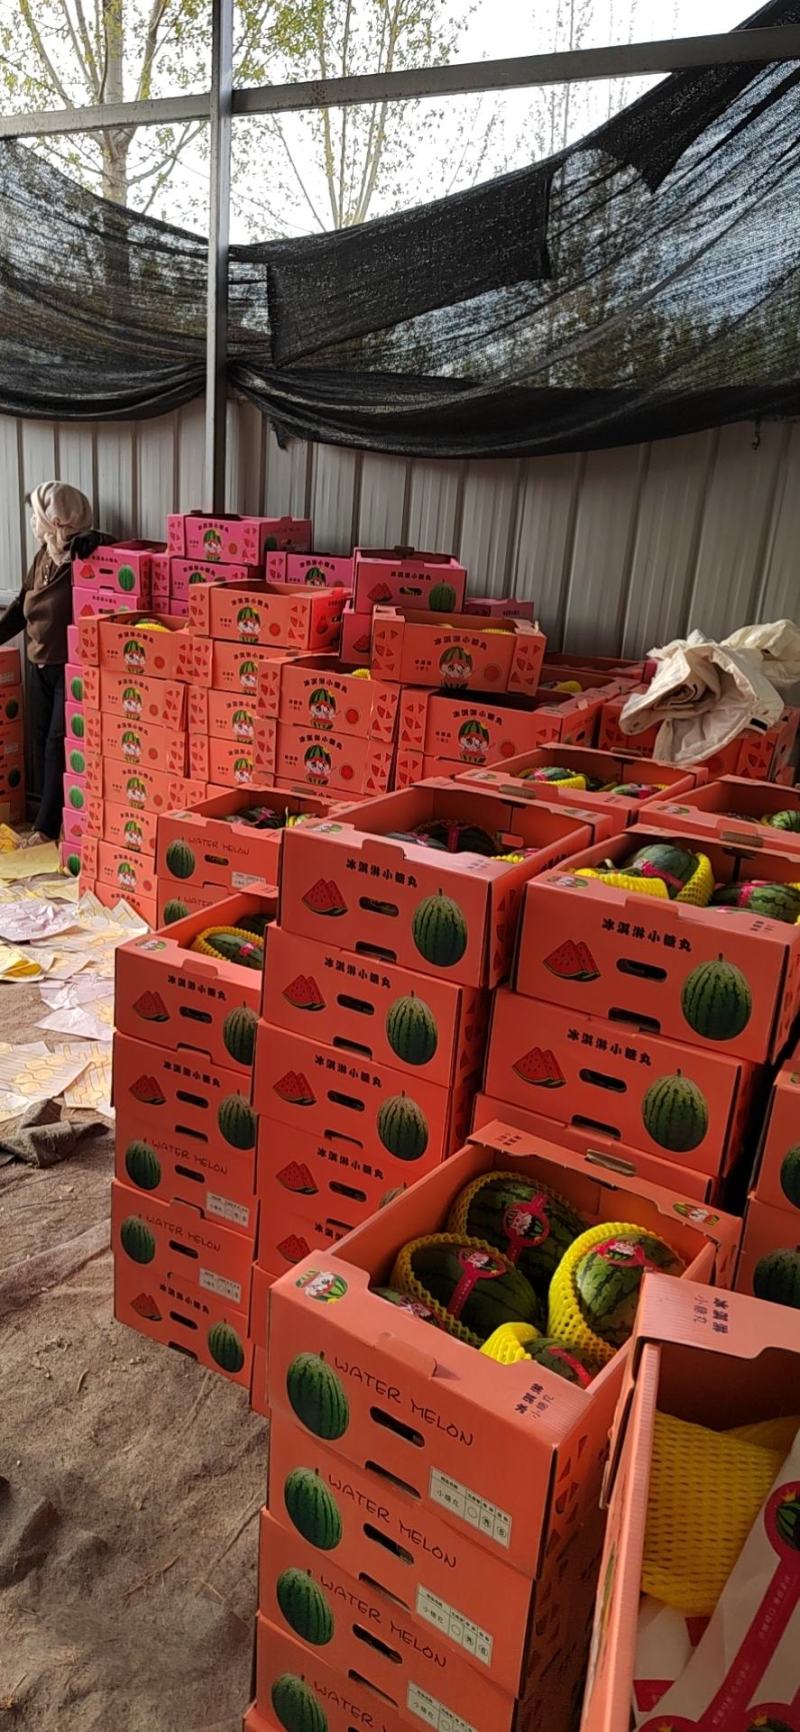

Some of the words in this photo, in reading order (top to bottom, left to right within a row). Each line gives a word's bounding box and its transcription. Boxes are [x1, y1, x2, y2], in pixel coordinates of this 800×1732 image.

[346, 858, 418, 888] 冰淇淋小糖丸
[602, 917, 692, 952] 冰淇淋小糖丸
[324, 957, 391, 989] 冰淇淋小糖丸
[567, 1027, 652, 1067] 冰淇淋小糖丸
[314, 1054, 382, 1088] 冰淇淋小糖丸
[151, 1139, 190, 1160] WATER
[194, 1154, 228, 1176] MELON
[146, 1215, 184, 1237] WATER
[187, 1231, 221, 1253] MELON
[334, 1356, 401, 1404] WATER
[410, 1399, 474, 1447] MELON
[328, 1474, 391, 1524] WATER
[399, 1519, 457, 1569] MELON
[320, 1575, 382, 1625] WATER
[390, 1619, 447, 1669] MELON
[313, 1680, 375, 1728] WATER
